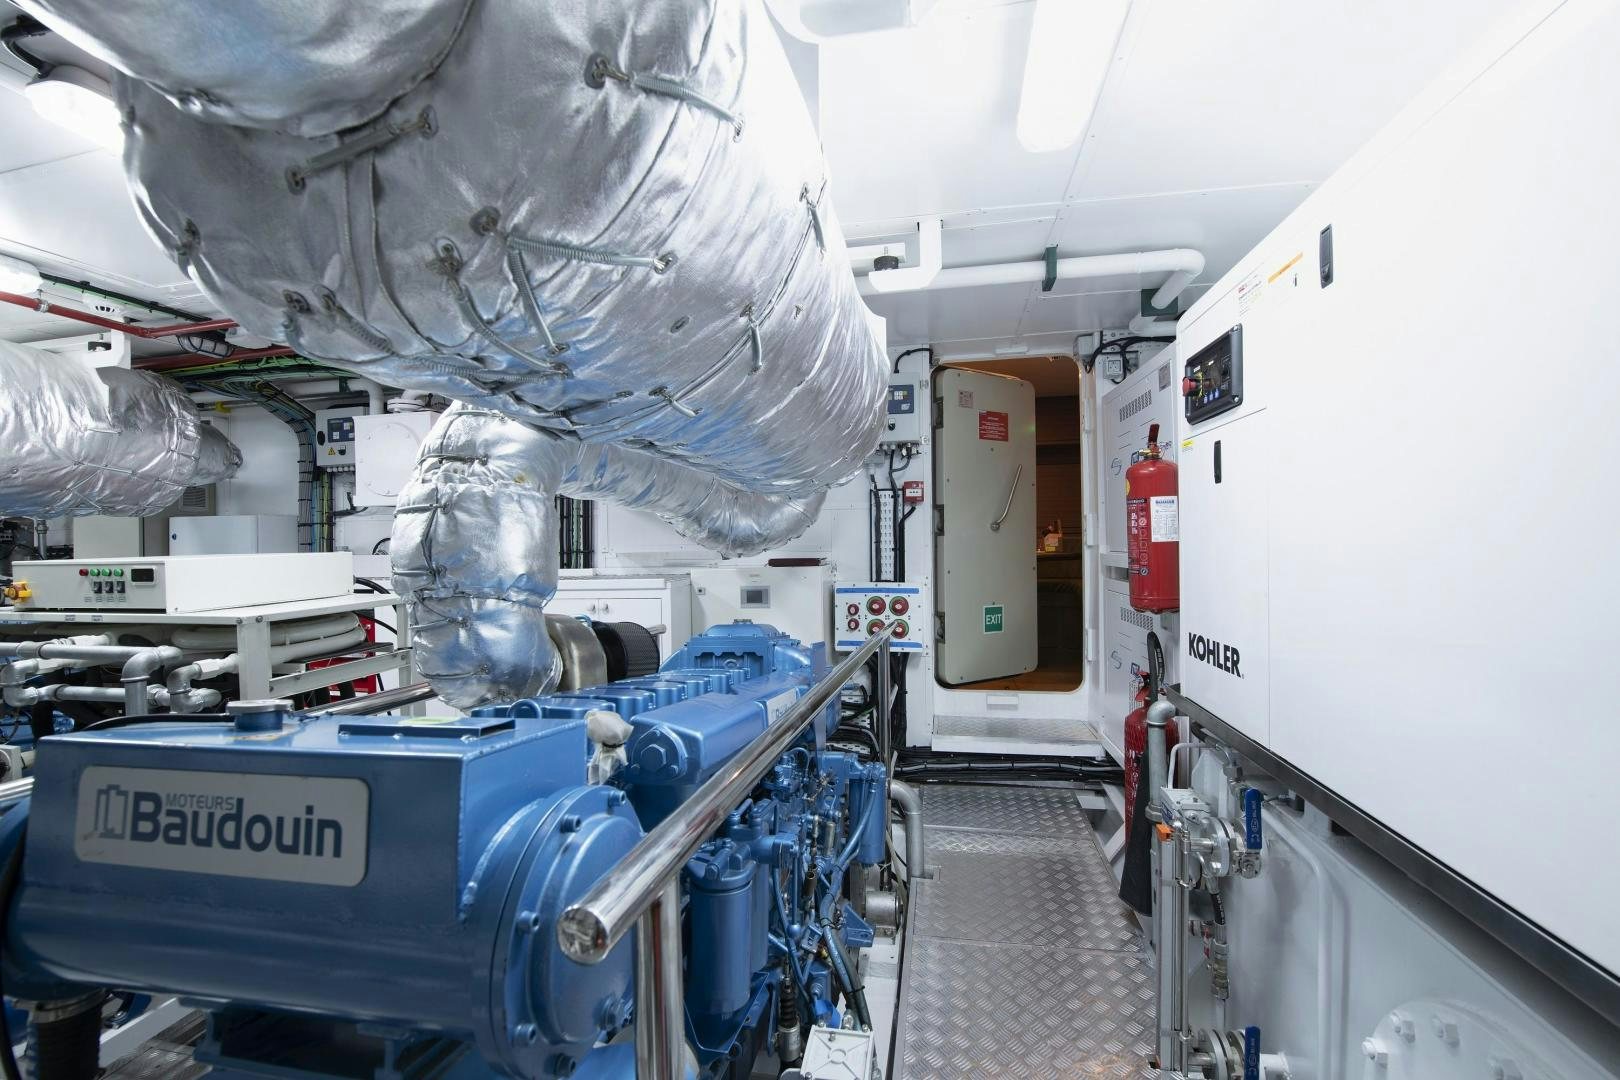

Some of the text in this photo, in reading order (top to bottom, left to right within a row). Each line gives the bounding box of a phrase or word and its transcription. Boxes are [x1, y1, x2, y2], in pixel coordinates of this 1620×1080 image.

[986, 614, 1002, 625] EXIT
[1188, 632, 1242, 678] KOHLER
[165, 793, 235, 811] MOTEURS
[130, 791, 342, 858] Baudouin
